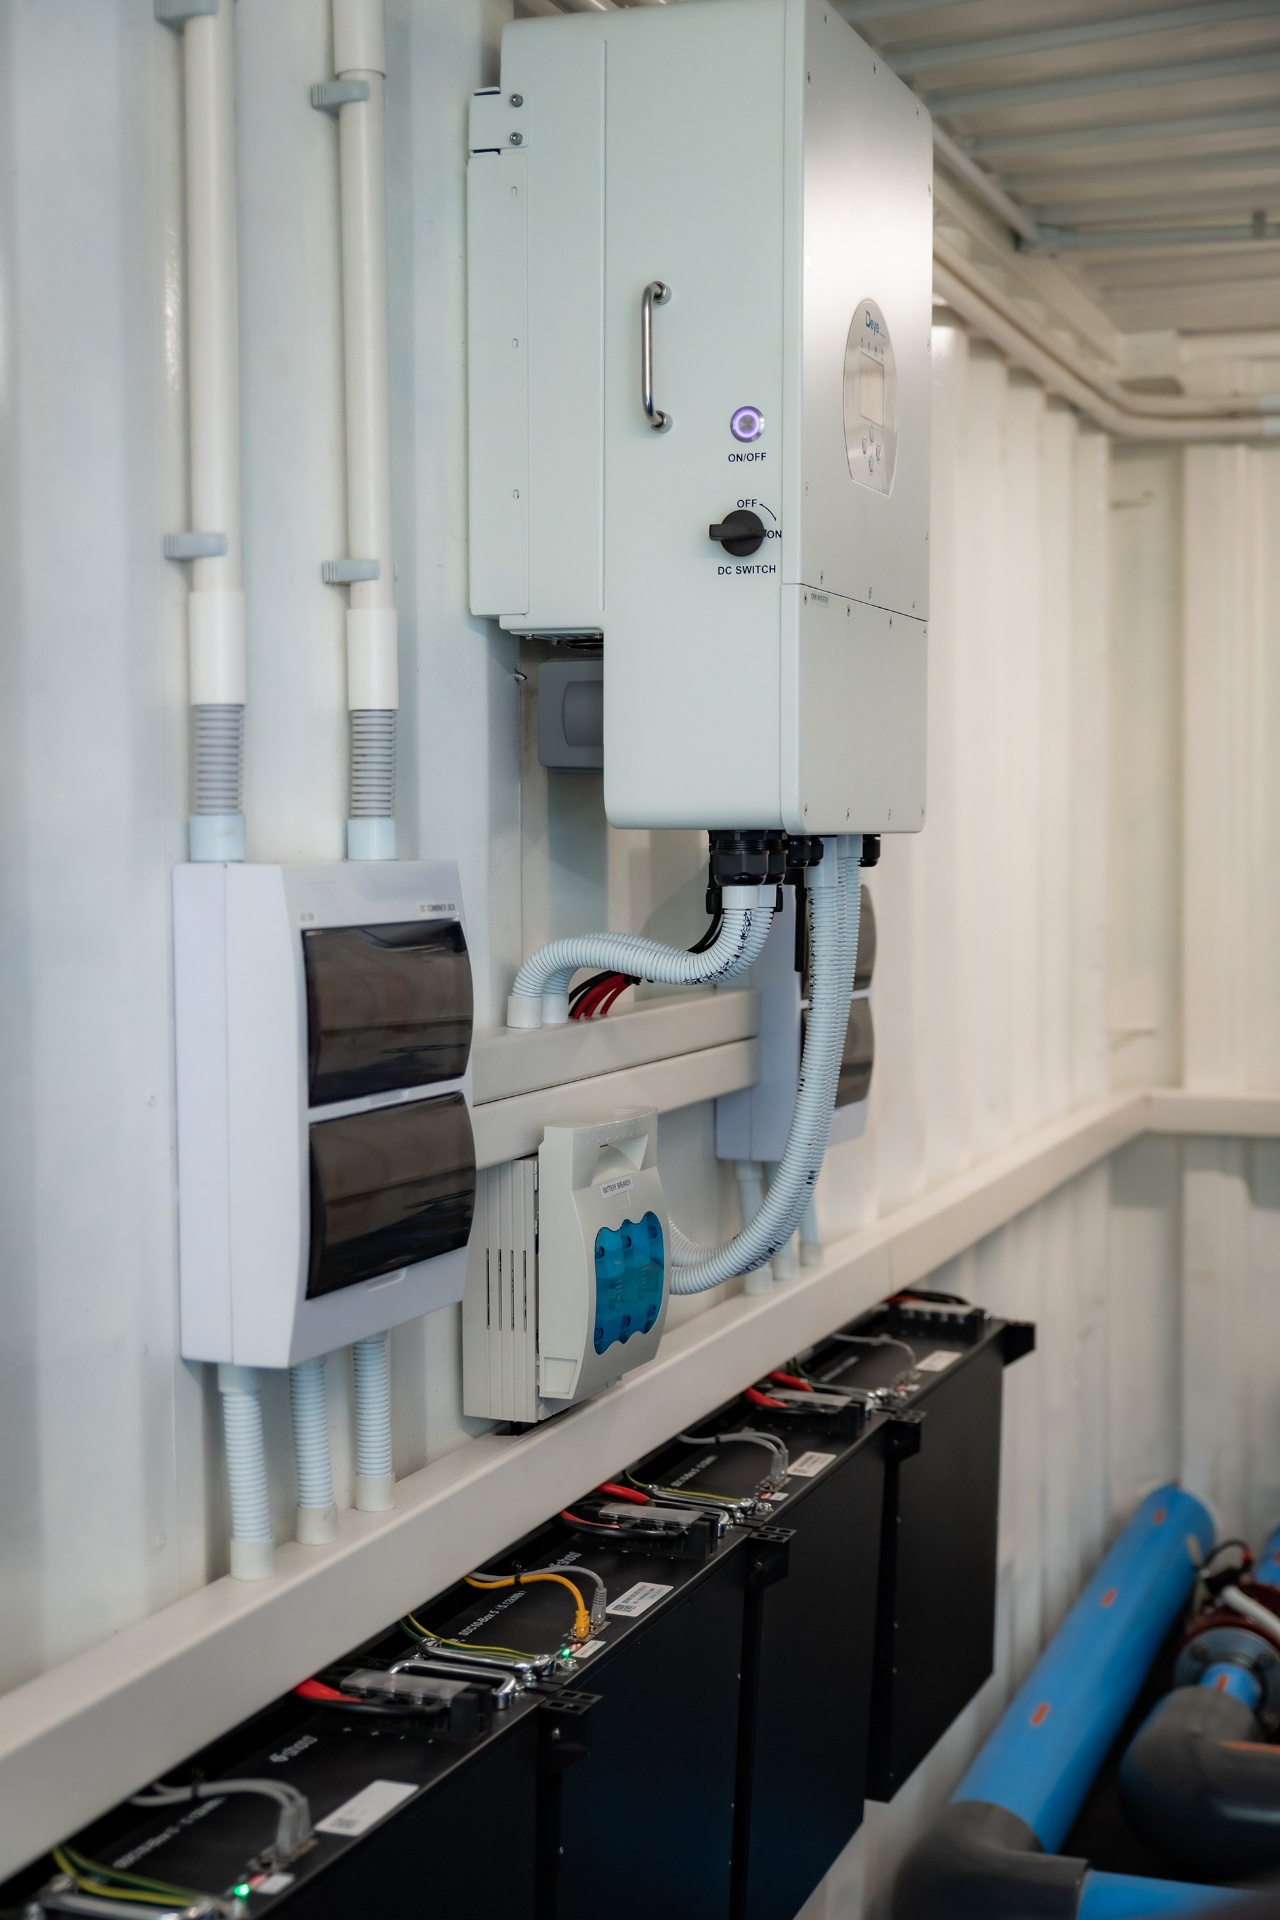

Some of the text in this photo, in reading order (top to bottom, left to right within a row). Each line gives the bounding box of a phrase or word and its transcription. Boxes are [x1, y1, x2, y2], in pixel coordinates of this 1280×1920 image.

[865, 309, 879, 336] Deye
[727, 452, 767, 463] ON/OFF
[736, 498, 758, 509] OFF
[766, 529, 782, 539] ON
[717, 564, 776, 575] DC SWITCH
